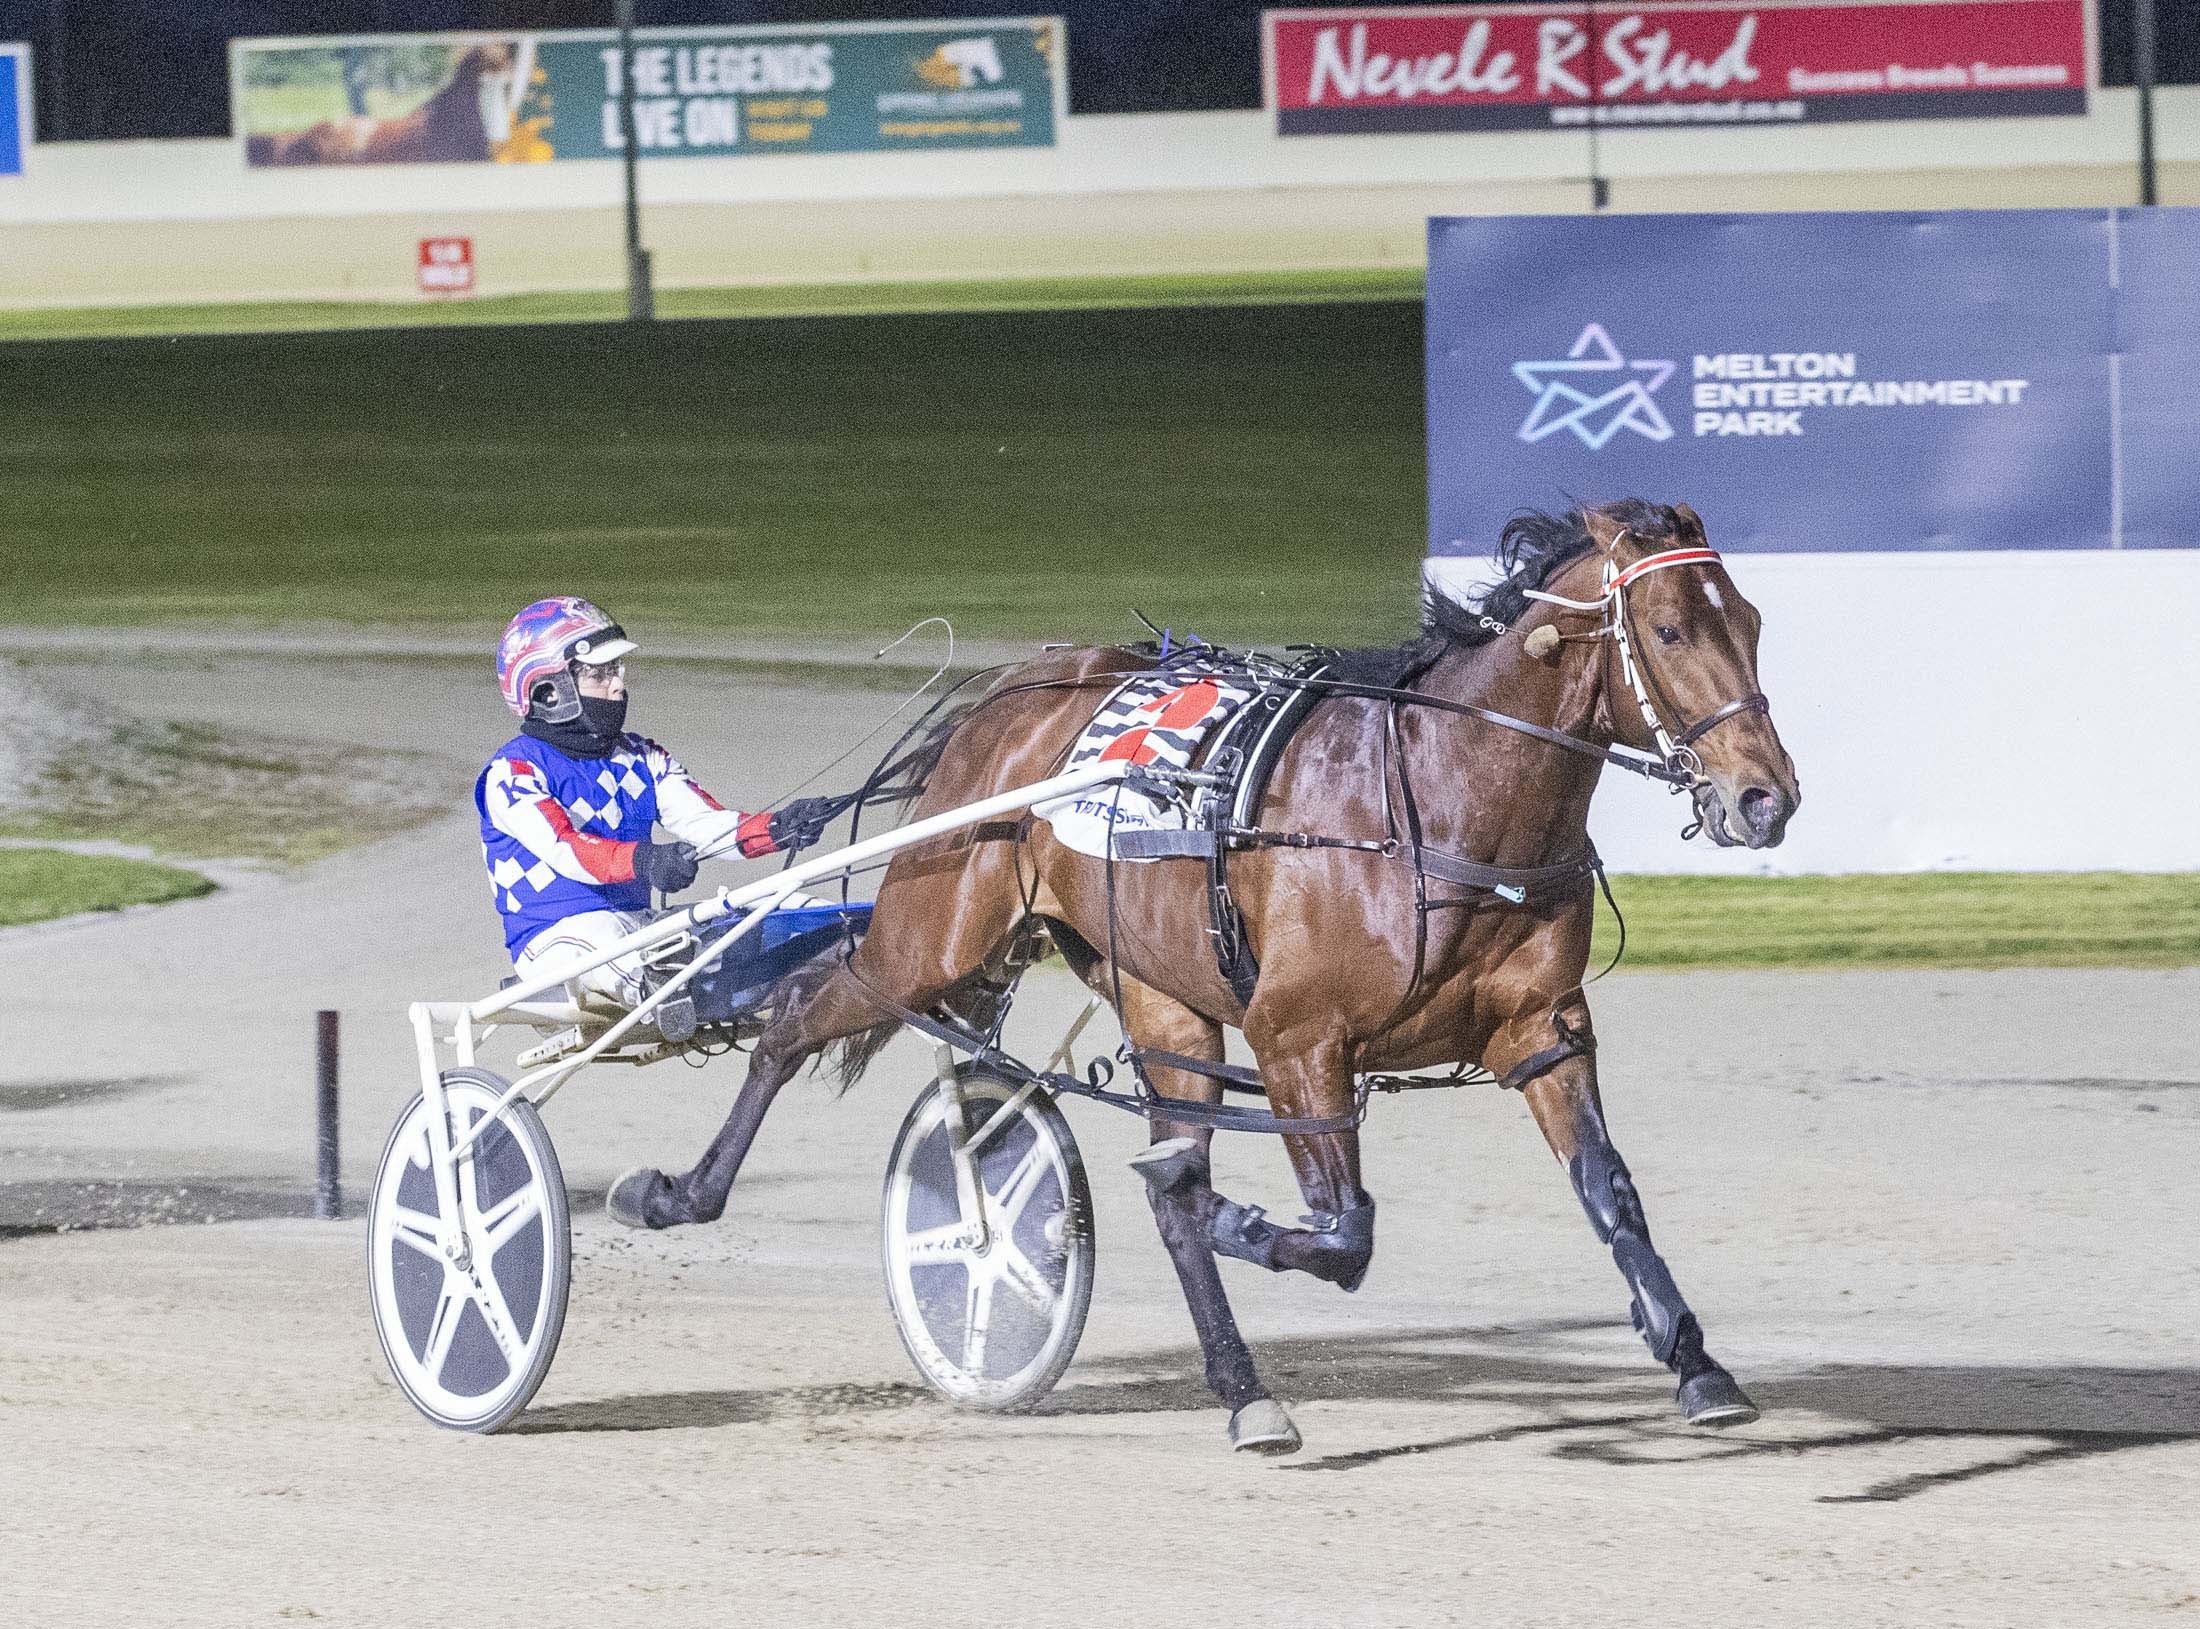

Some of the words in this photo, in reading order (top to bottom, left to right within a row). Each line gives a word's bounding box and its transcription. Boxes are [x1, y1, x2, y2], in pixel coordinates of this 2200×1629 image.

[676, 43, 834, 93] LEGENDS
[1307, 18, 1521, 104] Nevele
[1536, 17, 1591, 97] R
[1603, 15, 1760, 97] Stud
[684, 98, 738, 147] ON
[1692, 352, 1856, 379] MELTON
[1692, 379, 2029, 409] ENTERTAINMENT
[1692, 412, 1804, 438] PARK
